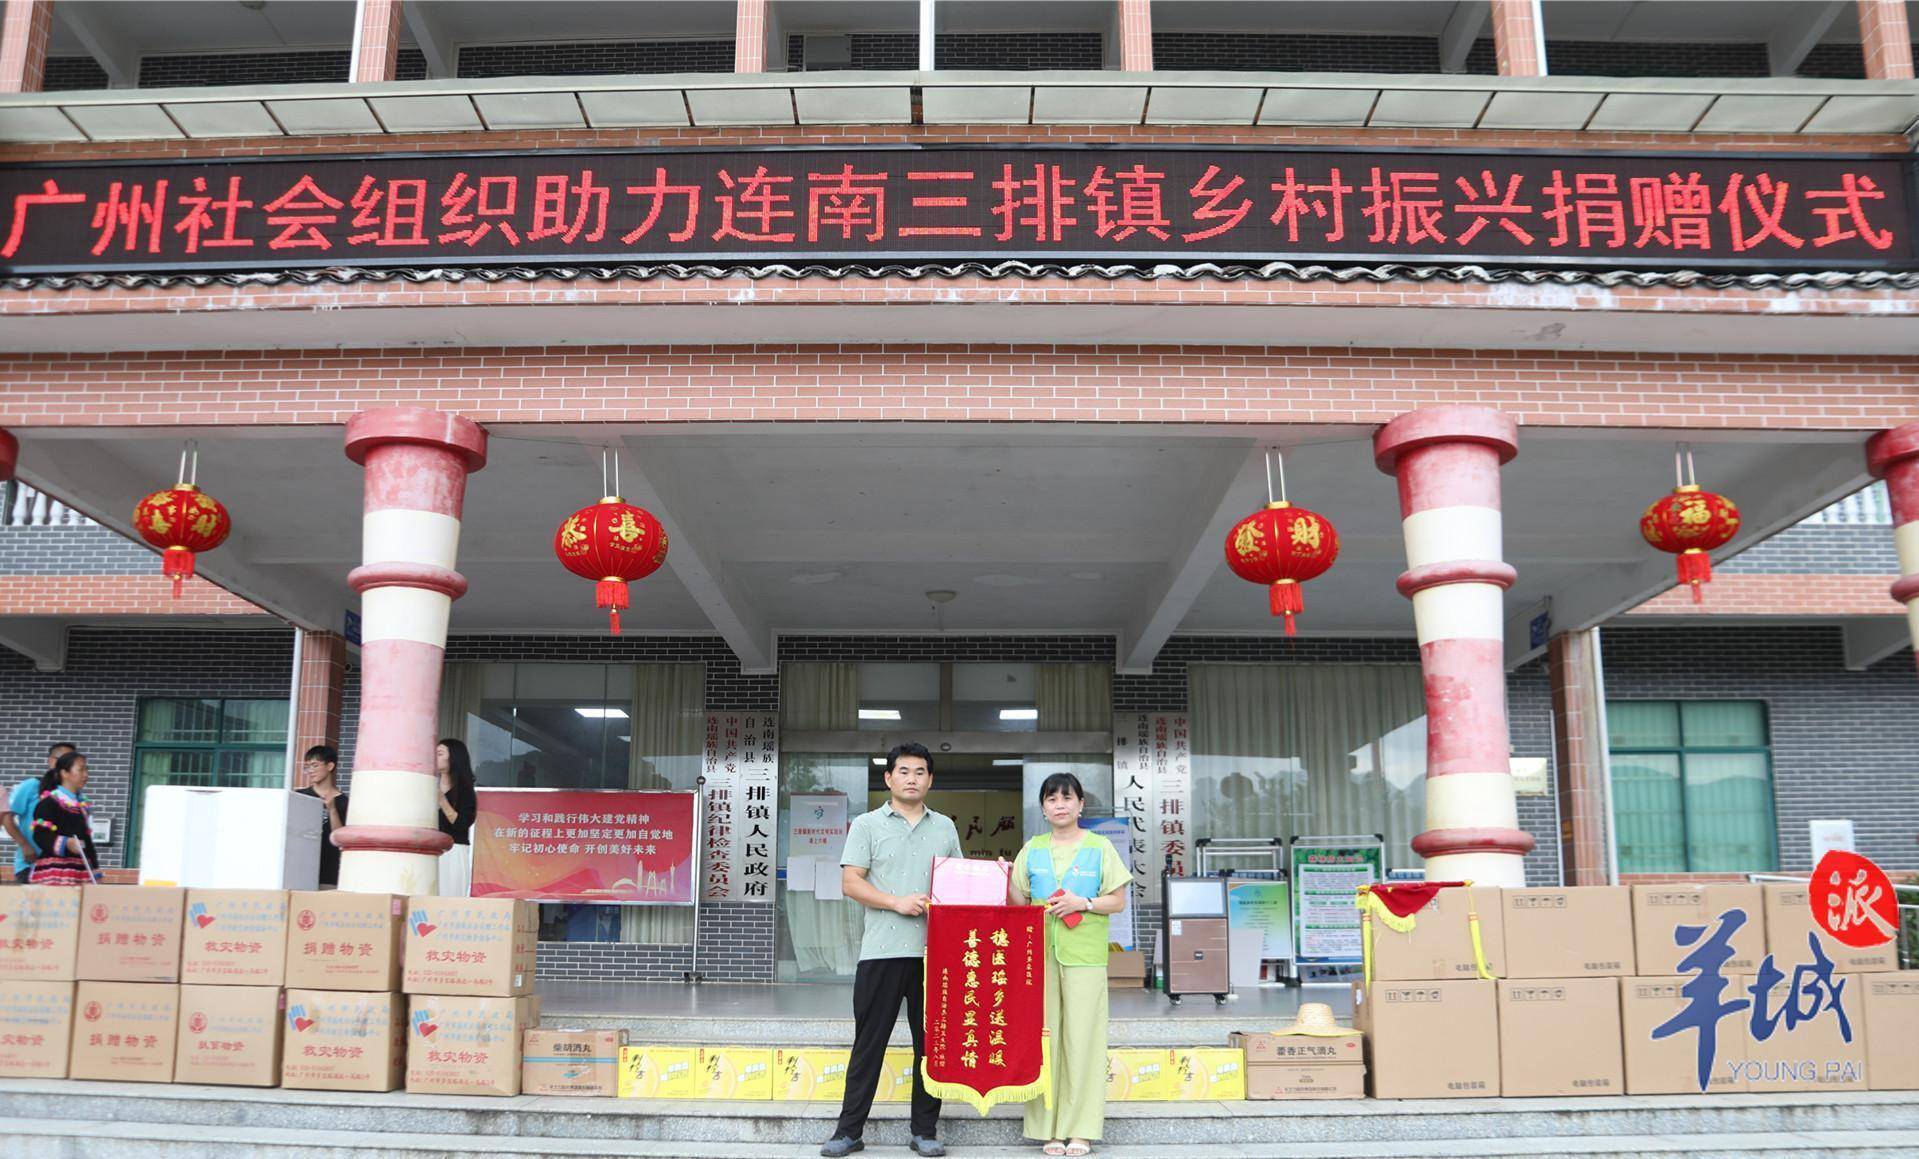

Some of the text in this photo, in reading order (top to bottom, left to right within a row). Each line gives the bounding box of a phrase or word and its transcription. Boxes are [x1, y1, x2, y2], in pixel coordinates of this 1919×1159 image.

[1, 161, 1894, 257] 广州社会组织助力连南三排镇乡村振兴捐赠仪式
[705, 715, 718, 774] 连南瑶族自治县
[725, 716, 737, 774] 中国共产党
[743, 716, 756, 764] 自治县
[762, 716, 775, 764] 连南瑶族
[1137, 714, 1149, 770] 连南瑶族自治县
[1154, 716, 1168, 774] 连南瑶族自治县
[1174, 715, 1187, 775] 中国共产党
[518, 813, 650, 825] 学习和践行伟大建党精神
[495, 828, 674, 840] 在新的征程上更加坚定更加自觉地
[707, 778, 732, 897] 三排镇纪律检查委员会
[743, 768, 770, 897] 三排镇人民政府
[509, 843, 657, 855] 牢记初心使命 开创美好未来
[98, 933, 166, 947] 捐赠物资
[205, 941, 263, 953] 救灾物资
[303, 942, 374, 957] 捐赠物资
[425, 950, 487, 963] 救灾物资
[89, 1033, 158, 1048] 捐赠物资
[303, 1046, 363, 1058] 救灾物资
[427, 1050, 488, 1064] 救灾物资
[1276, 1046, 1337, 1056] 藿香正气滴丸
